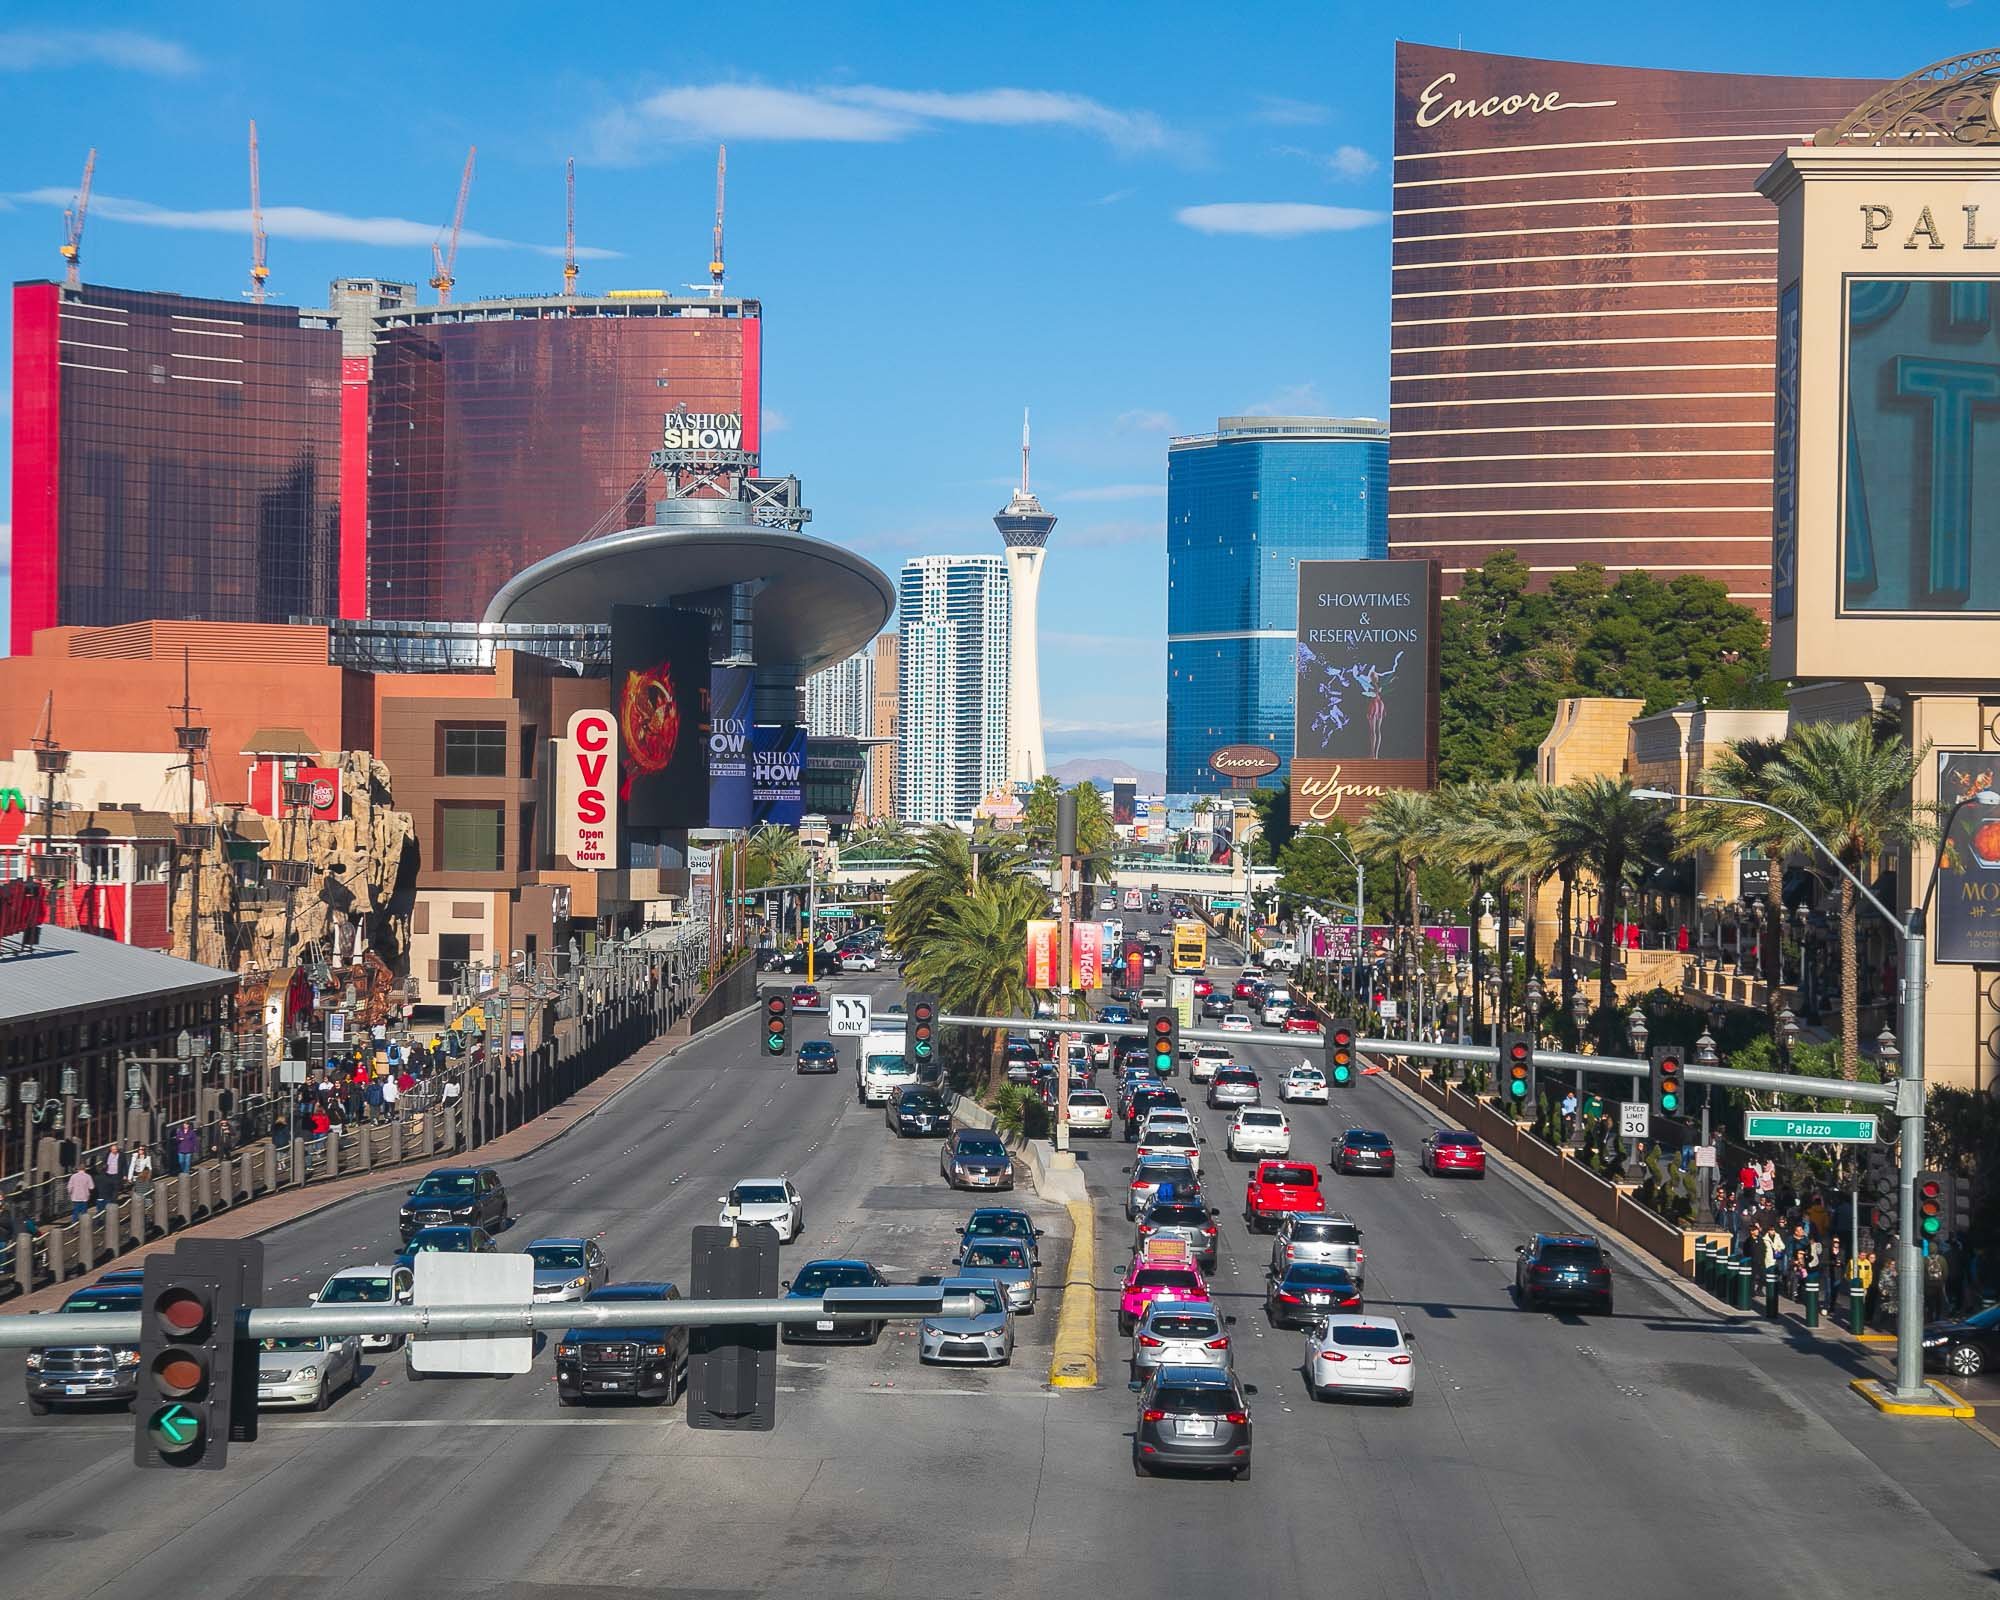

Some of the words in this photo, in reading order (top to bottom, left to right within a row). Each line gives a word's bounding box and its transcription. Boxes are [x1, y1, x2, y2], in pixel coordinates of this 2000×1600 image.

[1416, 72, 1617, 128] Encore
[1859, 204, 1998, 250] PAL
[664, 413, 742, 430] FASHION
[664, 430, 742, 449] SHOW
[1318, 593, 1411, 608] SHOWTIMES
[1359, 612, 1371, 625] &
[1308, 629, 1417, 644] RESERVATIONS
[1215, 752, 1278, 768] Encore
[576, 717, 609, 825] CVS
[1301, 764, 1386, 819] Wynn
[579, 829, 603, 840] Open
[585, 841, 597, 850] 24
[577, 851, 605, 861] Hours
[1080, 952, 1095, 986] VEGAS
[837, 1021, 863, 1030] ONLY
[1625, 1122, 1645, 1132] 30
[1787, 1122, 1831, 1135] Palazzo
